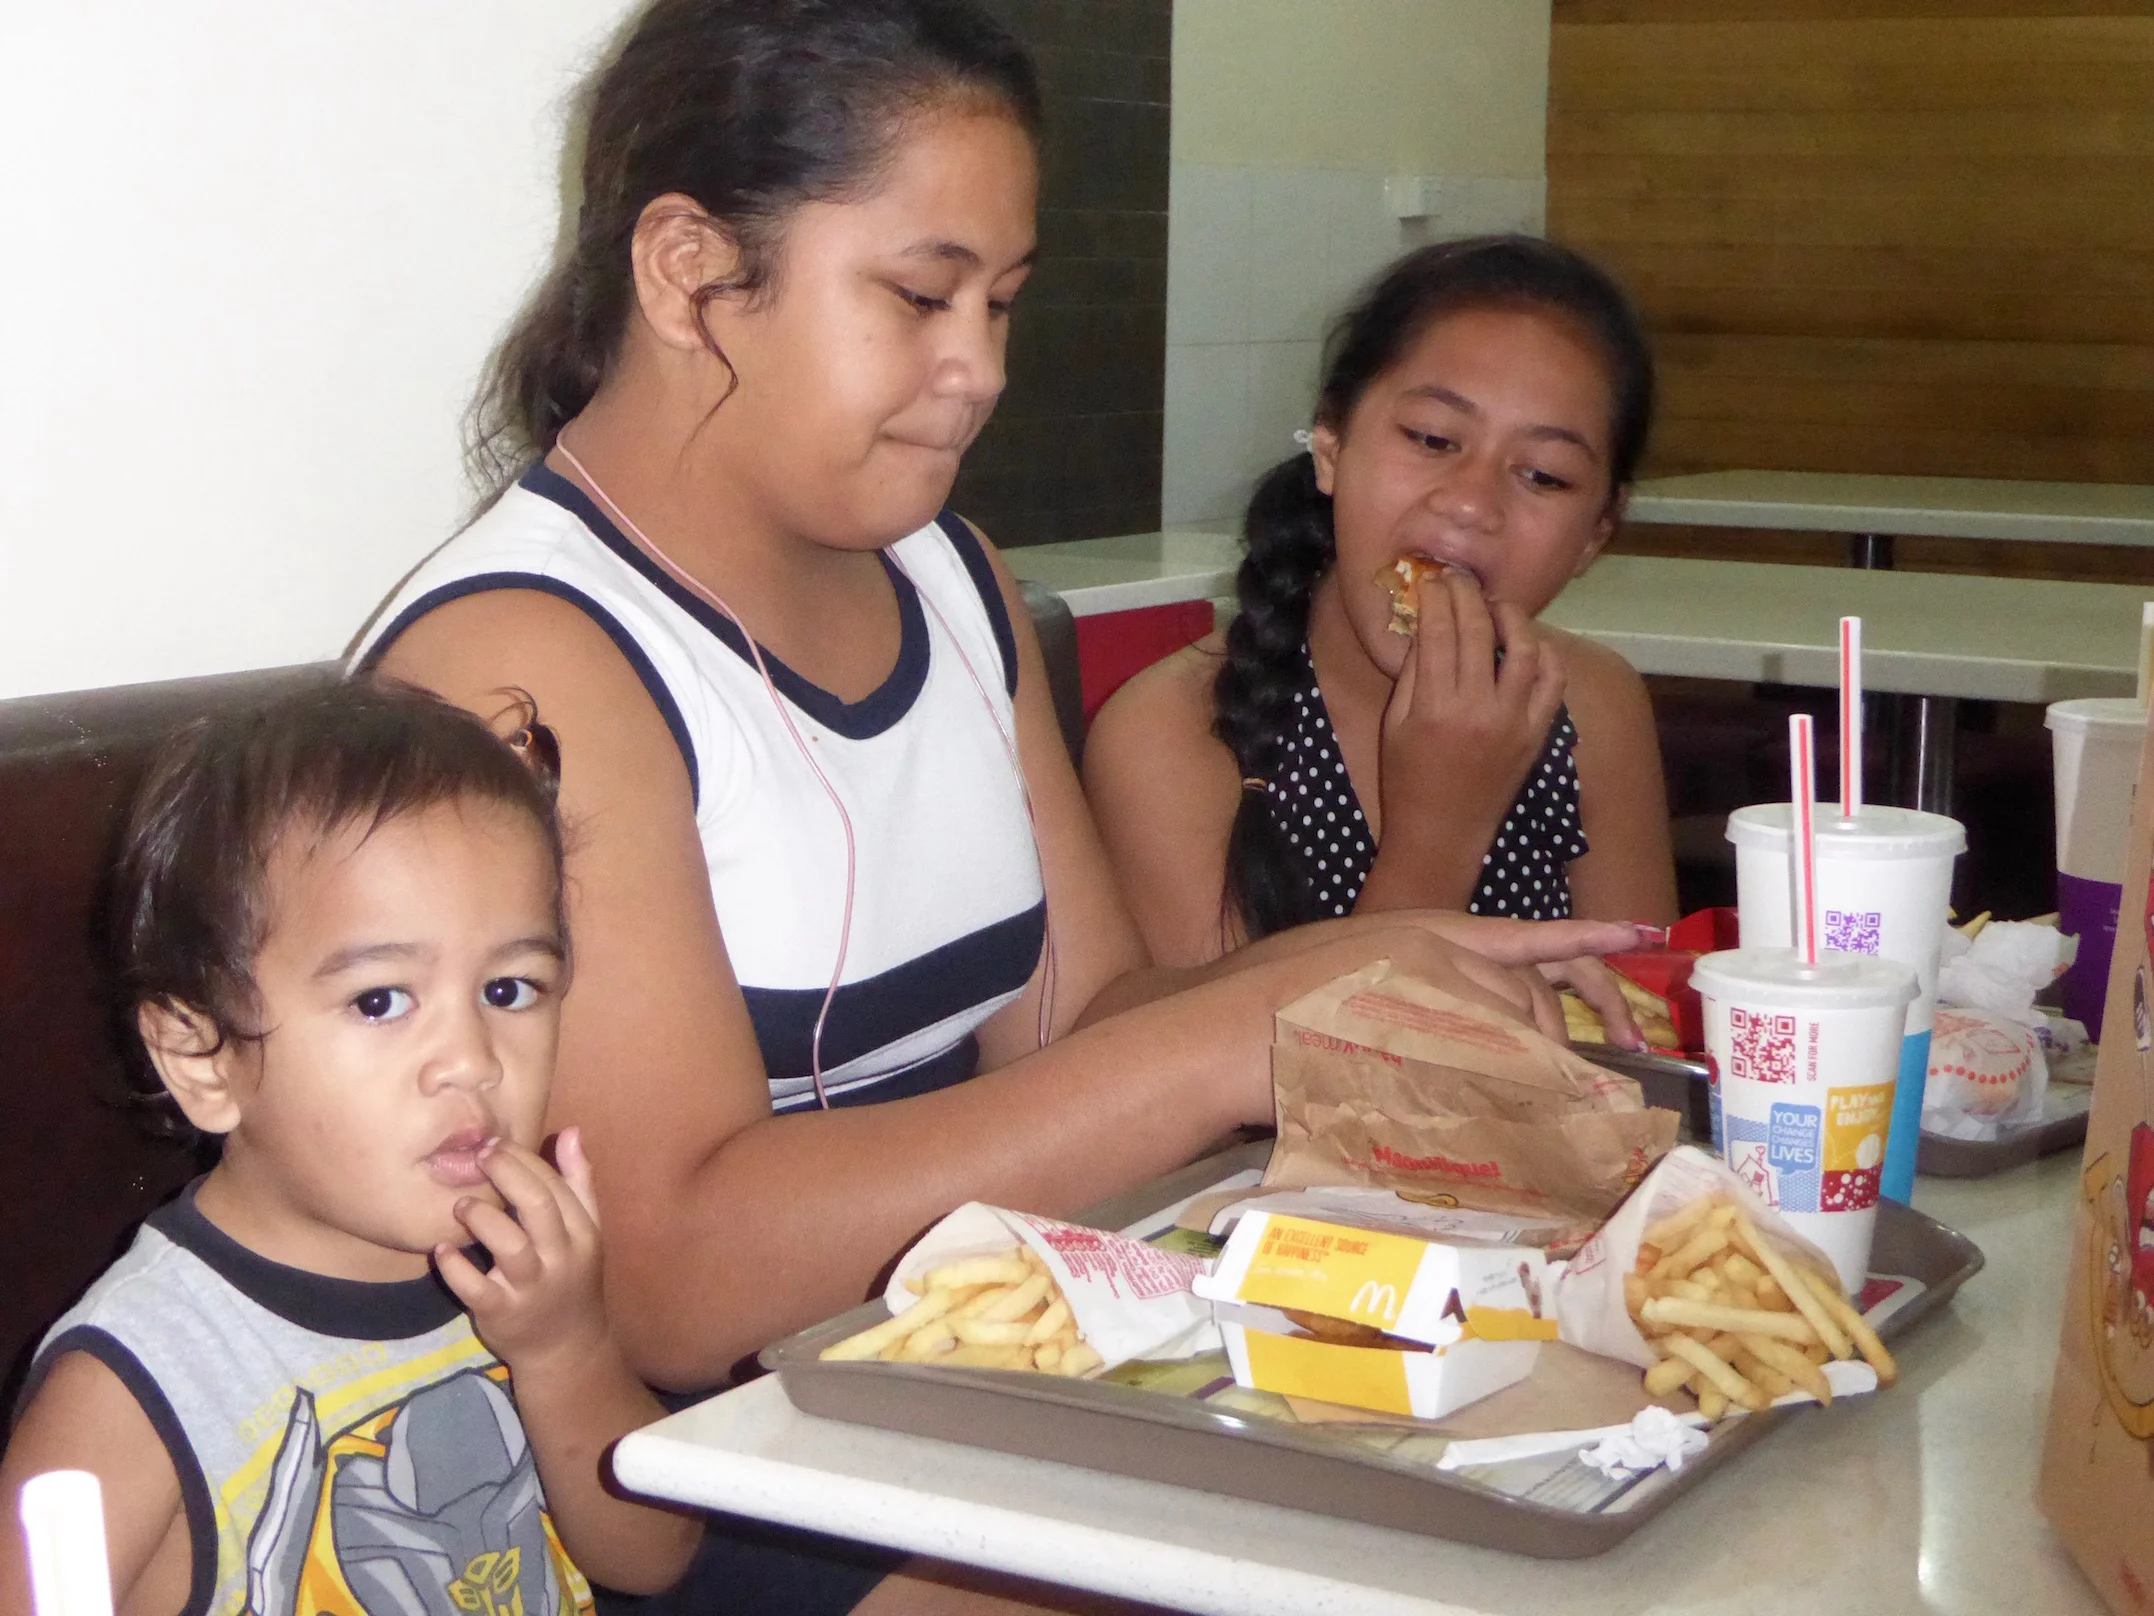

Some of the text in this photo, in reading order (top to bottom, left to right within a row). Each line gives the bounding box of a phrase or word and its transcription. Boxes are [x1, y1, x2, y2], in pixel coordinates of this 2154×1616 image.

[1807, 1022, 1819, 1081] SCAN FOR MORE
[1831, 1094, 1869, 1110] PLAY
[1773, 1111, 1817, 1127] YOUR
[1771, 1145, 1814, 1163] LIVES
[1285, 1229, 1334, 1248] EXCELLENT
